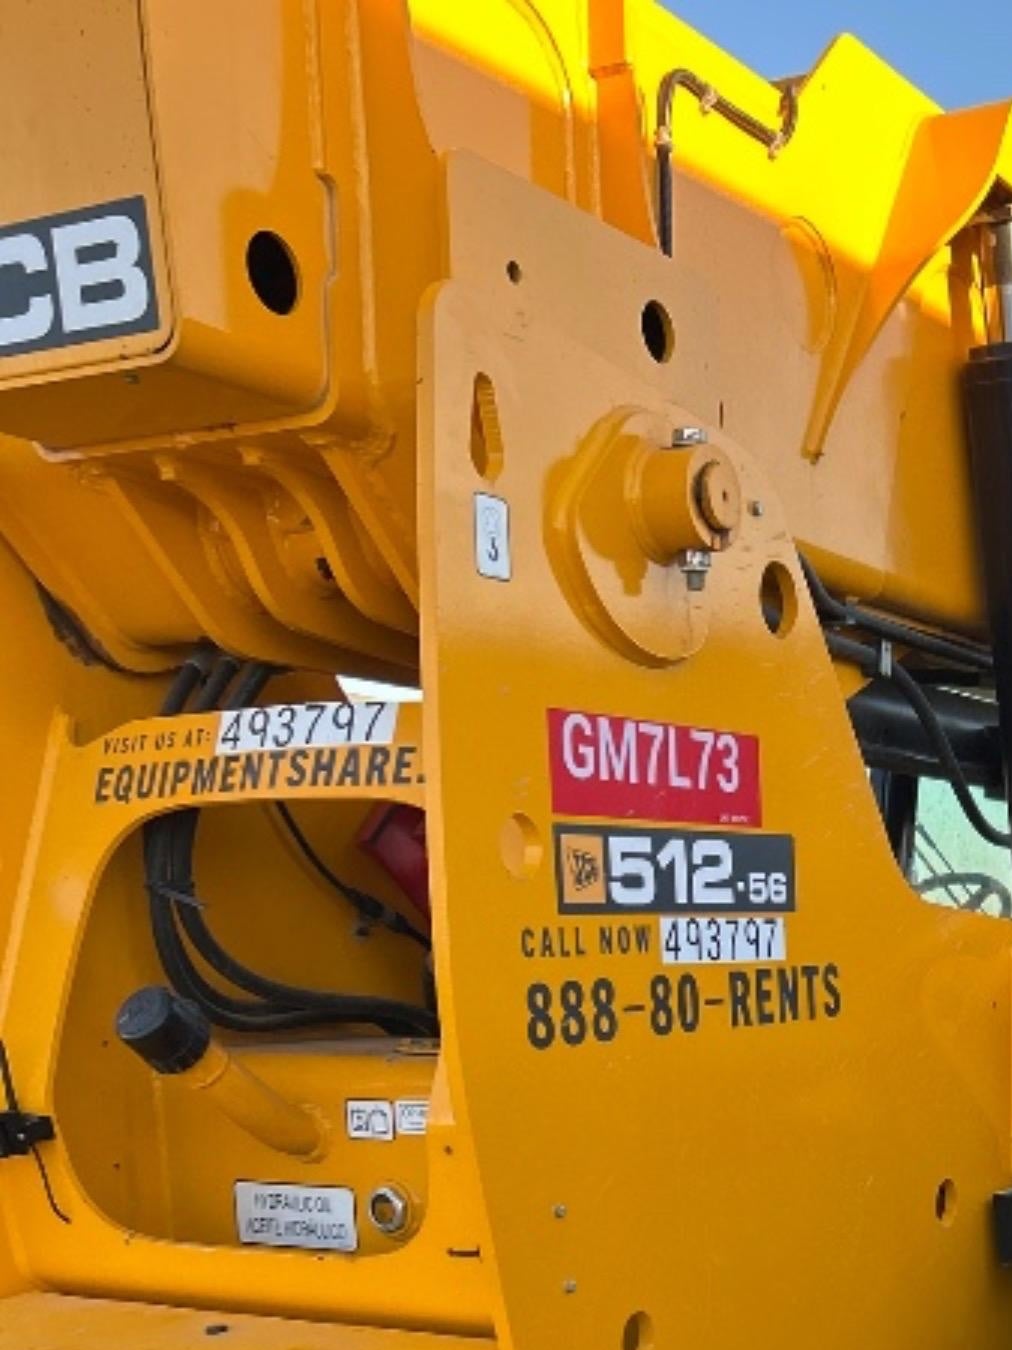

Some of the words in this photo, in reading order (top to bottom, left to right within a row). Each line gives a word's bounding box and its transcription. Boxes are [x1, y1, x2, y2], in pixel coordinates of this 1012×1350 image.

[103, 733, 147, 755] VISIT
[154, 730, 175, 749] US
[183, 728, 212, 748] AT:
[221, 701, 387, 751] 493797
[562, 713, 740, 793] GM7L73
[521, 927, 586, 958] CALL
[600, 925, 650, 955] NOW
[664, 917, 779, 962] 493797
[527, 963, 842, 1050] 888-80-RENTS
